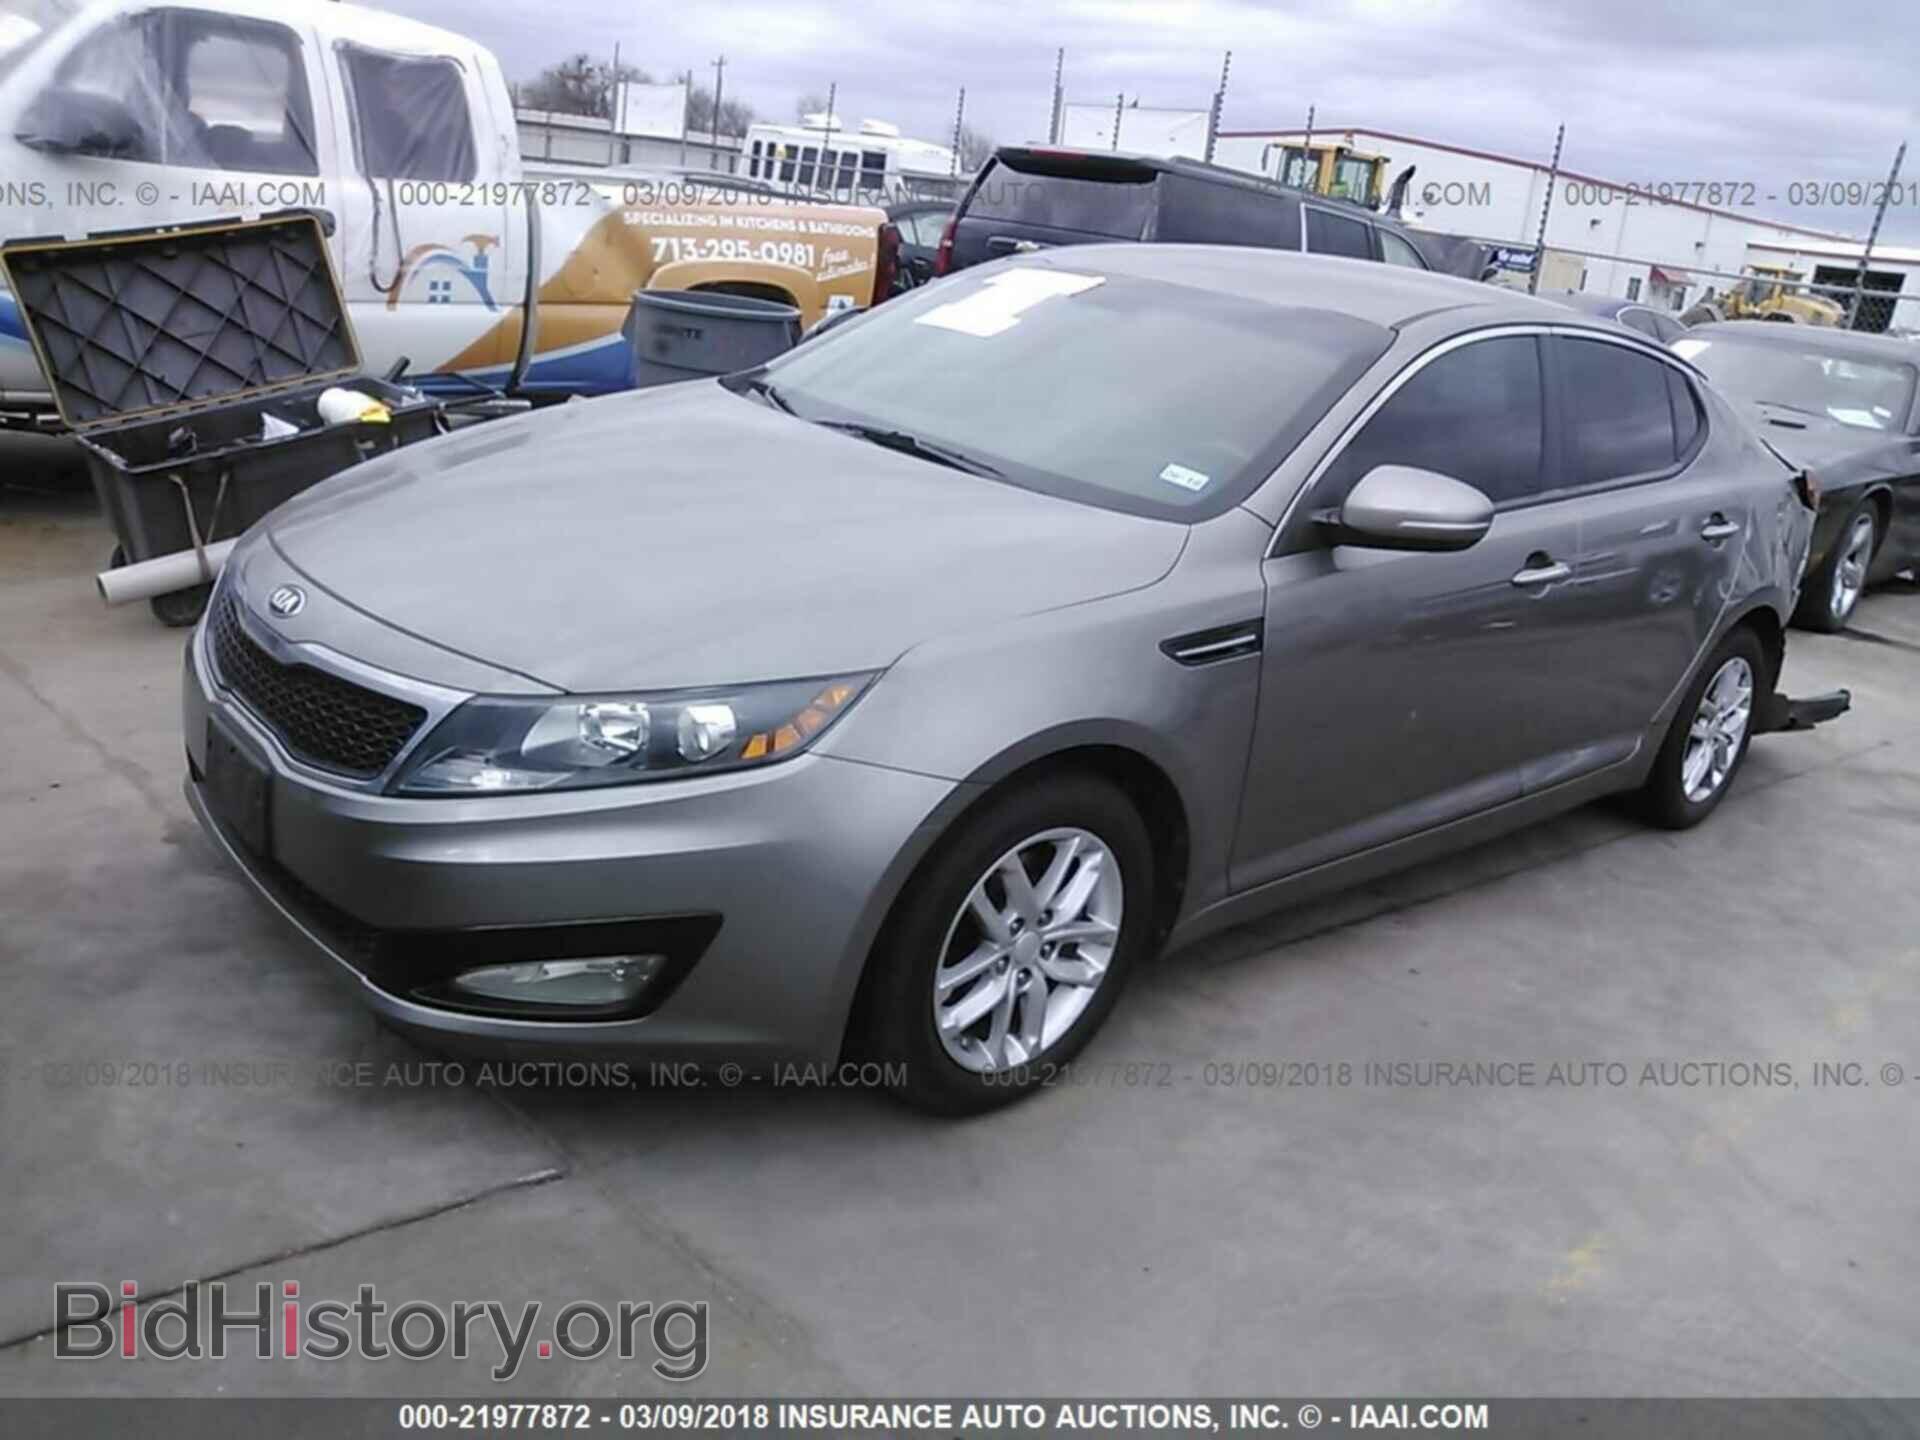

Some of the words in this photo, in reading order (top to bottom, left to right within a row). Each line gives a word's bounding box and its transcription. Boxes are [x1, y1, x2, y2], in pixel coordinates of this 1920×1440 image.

[624, 211, 718, 226] SPECIALIZING
[720, 214, 734, 227] IN
[736, 215, 796, 232] KITCHENS
[651, 237, 815, 268] 713-295-0981
